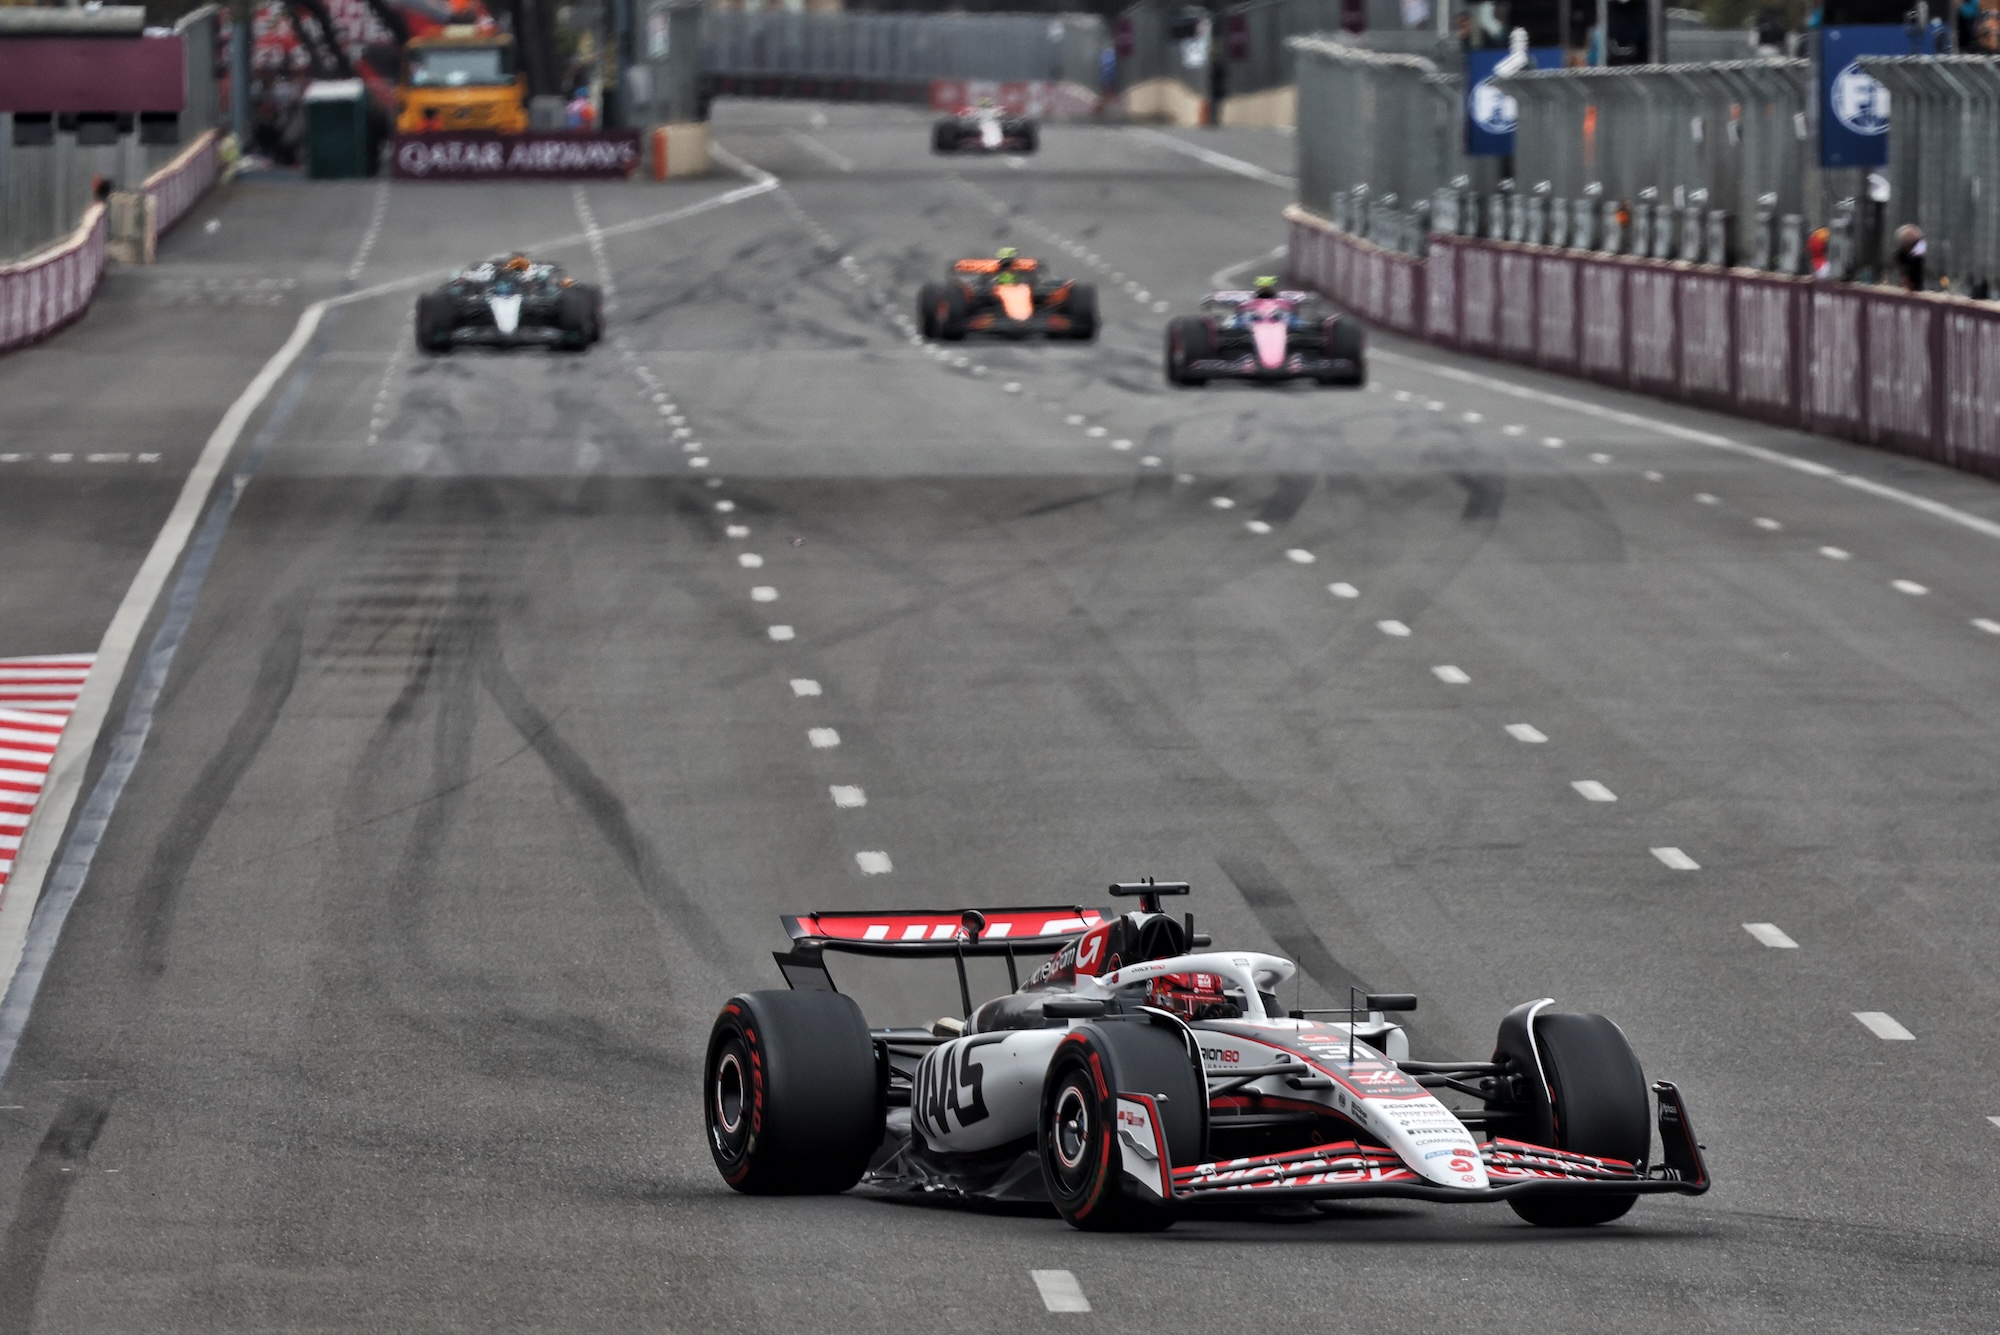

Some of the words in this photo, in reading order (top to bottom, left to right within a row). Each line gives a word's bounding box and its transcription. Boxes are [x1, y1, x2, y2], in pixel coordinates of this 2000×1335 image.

[399, 140, 504, 176] QATAR
[1200, 1047, 1240, 1063] RION180
[1308, 1045, 1378, 1060] 31
